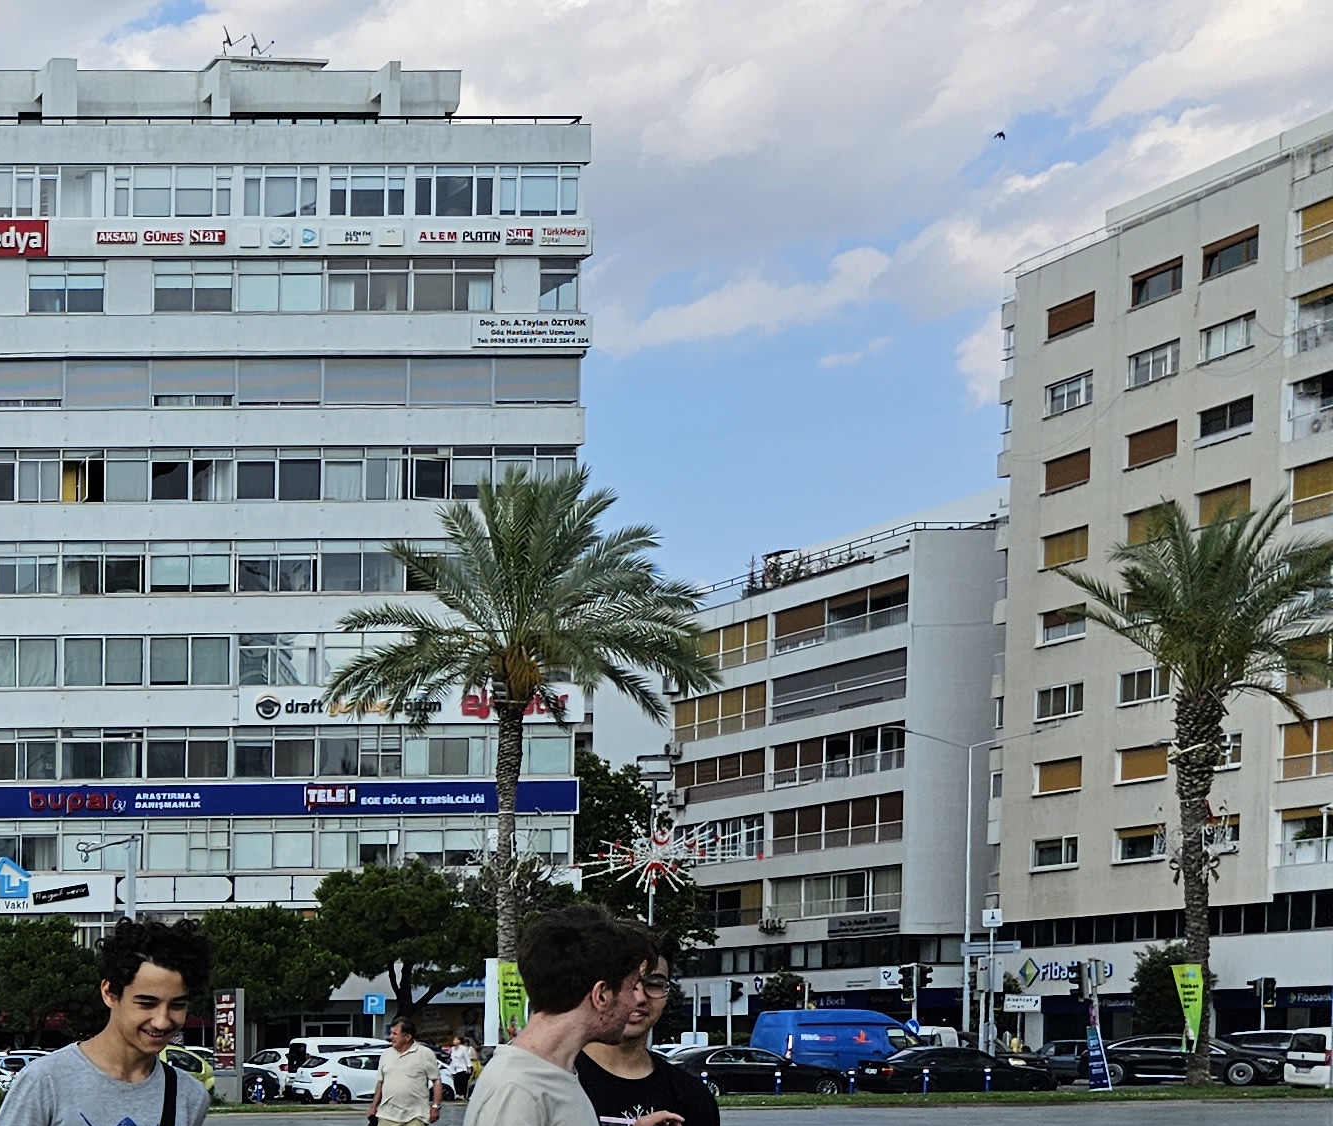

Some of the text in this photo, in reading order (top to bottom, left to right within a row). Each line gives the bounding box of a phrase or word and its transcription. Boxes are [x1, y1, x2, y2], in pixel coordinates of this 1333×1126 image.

[419, 231, 458, 240] ALEM
[551, 318, 586, 327] ÖZTÜRK
[285, 697, 323, 714] draft
[360, 797, 381, 805] EGE
[383, 794, 417, 805] BÖLGE
